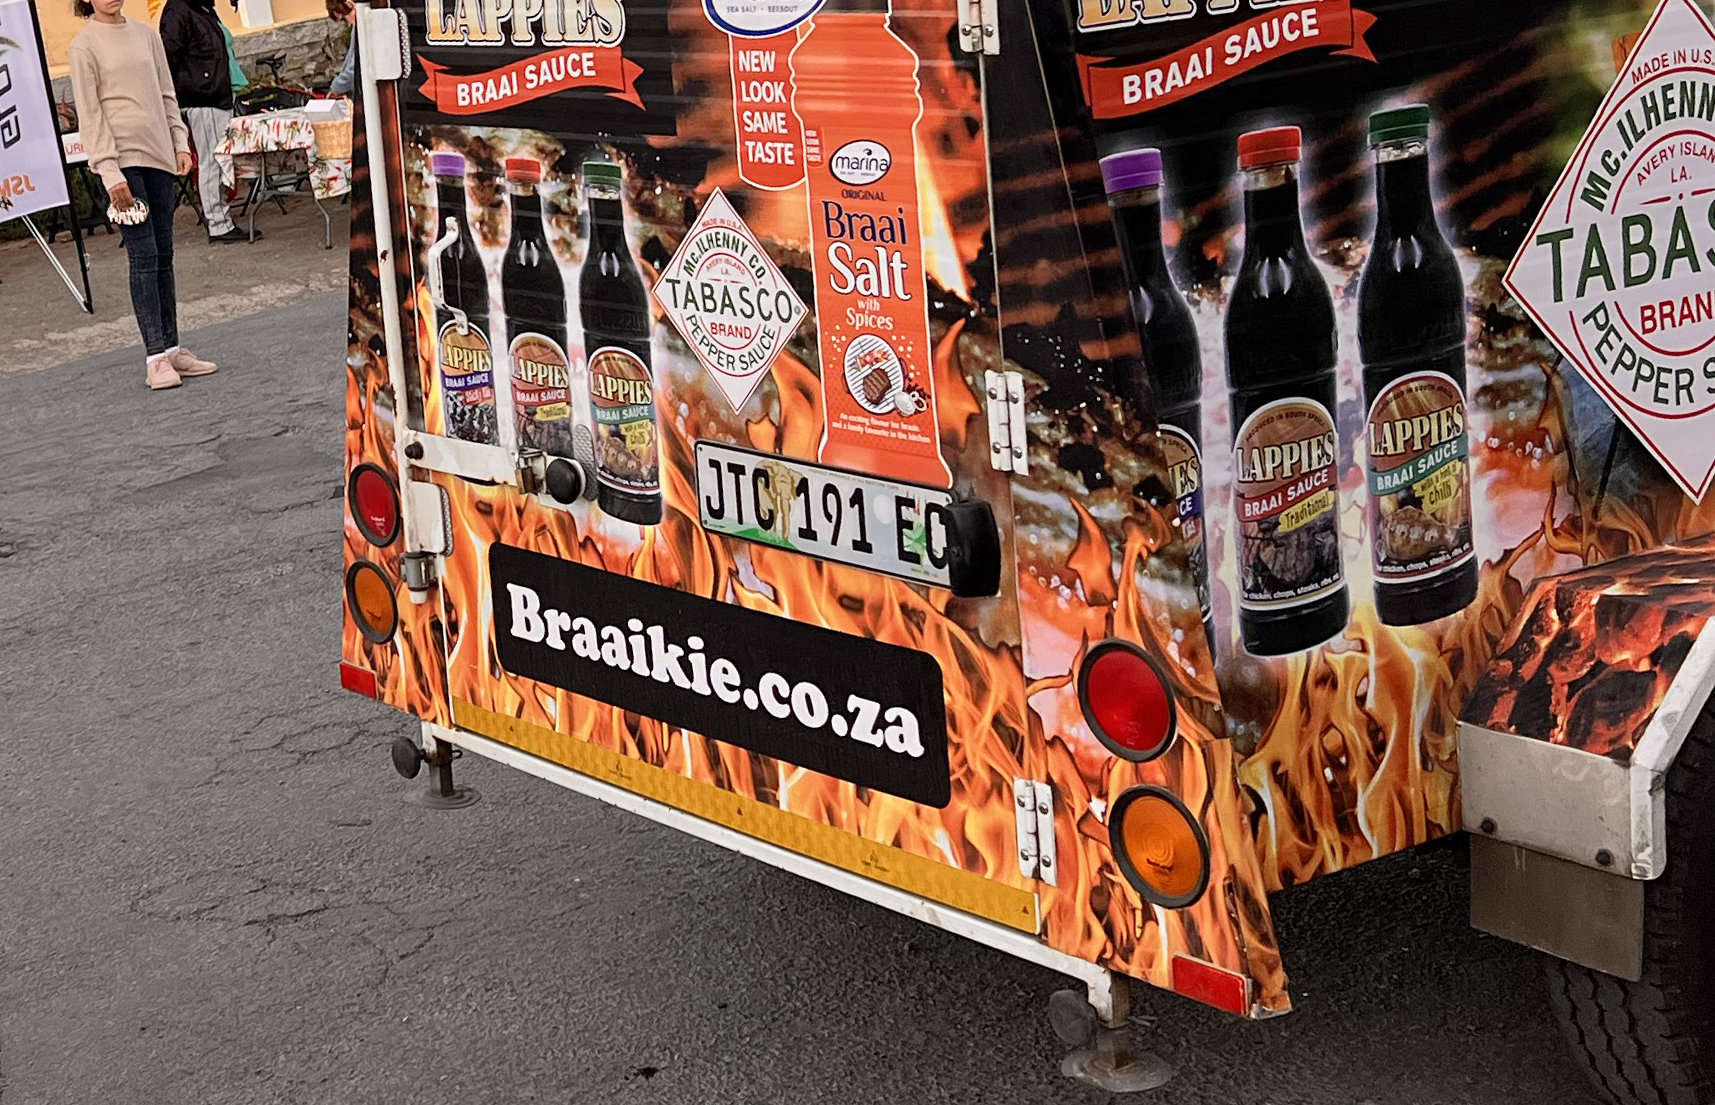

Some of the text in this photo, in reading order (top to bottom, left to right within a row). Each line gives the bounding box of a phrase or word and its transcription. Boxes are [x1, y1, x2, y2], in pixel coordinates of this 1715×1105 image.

[739, 50, 775, 73] NEW
[1122, 8, 1320, 105] BRAAI SAUCE
[1631, 52, 1670, 85] MADE
[1673, 48, 1687, 65] IN
[457, 52, 597, 107] BRAAI SAUCE
[741, 81, 786, 104] LOOK
[743, 111, 788, 134] SAME
[745, 141, 795, 165] TASTE
[835, 152, 889, 172] marina
[1637, 144, 1675, 187] AVERY
[841, 188, 887, 202] ORIGINAL
[1671, 166, 1693, 184] LA.
[822, 200, 907, 244] Braai
[827, 240, 912, 301] Salt
[665, 277, 793, 323] TABASCO
[845, 306, 894, 331] Spices
[857, 298, 881, 312] with
[686, 314, 775, 371] PEPPER SAUCE
[710, 321, 752, 340] BRAND
[1582, 300, 1695, 407] PEPPER
[590, 370, 652, 405] LAPPIES
[622, 405, 649, 420] SAUCE
[1369, 403, 1464, 456] LAPPIES
[1237, 429, 1334, 483] LAPPIES
[1377, 440, 1459, 491] BRAAI SAUCE
[705, 458, 775, 531] JTC
[795, 476, 873, 554] 191
[1244, 470, 1329, 518] BRAAI SAUCE
[1284, 491, 1331, 529] Traditional
[507, 583, 925, 758] Braaikie.co.za
